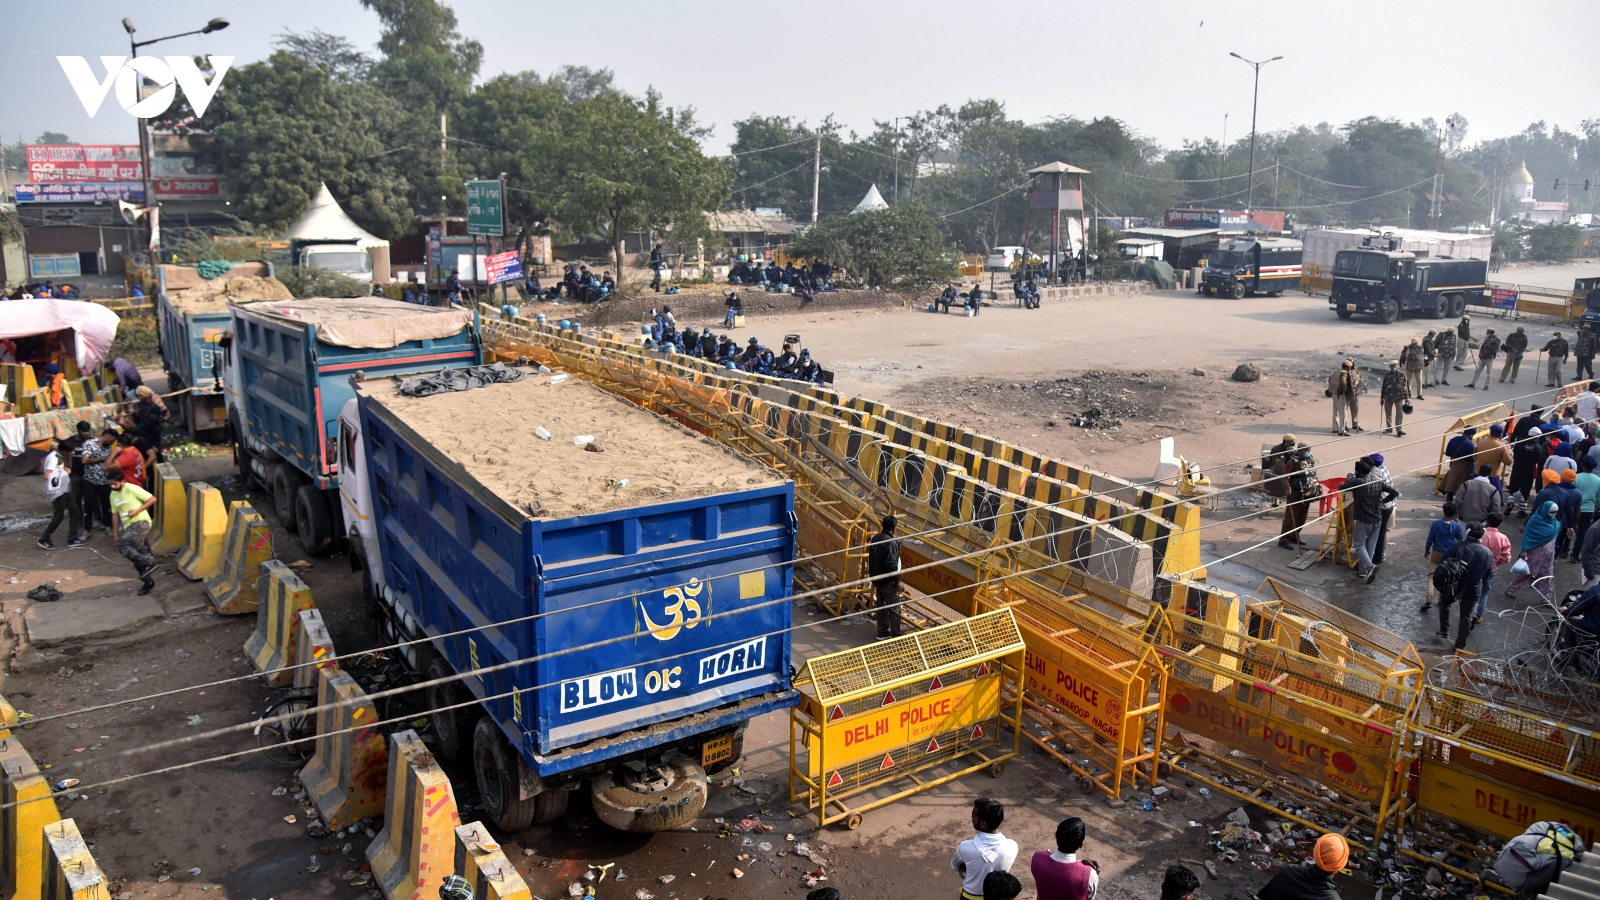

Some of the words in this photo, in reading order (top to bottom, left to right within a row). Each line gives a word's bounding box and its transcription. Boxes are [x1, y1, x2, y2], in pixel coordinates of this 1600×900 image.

[29, 147, 48, 162] ECO
[48, 147, 84, 162] DIGITAL
[174, 181, 214, 190] MRF
[901, 551, 925, 578] DELHI
[928, 564, 959, 594] POLICE
[563, 670, 634, 710] BLOW
[644, 665, 682, 694] OK
[701, 640, 764, 682] HORN
[1025, 650, 1046, 677] ELHI
[1056, 669, 1099, 708] POLICE
[844, 717, 889, 748] DELHI
[900, 698, 951, 728] POLICE
[1028, 676, 1038, 689] TO
[1054, 693, 1090, 720] SWAROOP
[1092, 713, 1119, 741] NAGAR
[1196, 701, 1250, 736] DELHI
[1263, 725, 1330, 767] POLICE
[1286, 757, 1316, 773] OUTER
[1317, 769, 1345, 784] NORTH
[1475, 788, 1537, 825] DELHI
